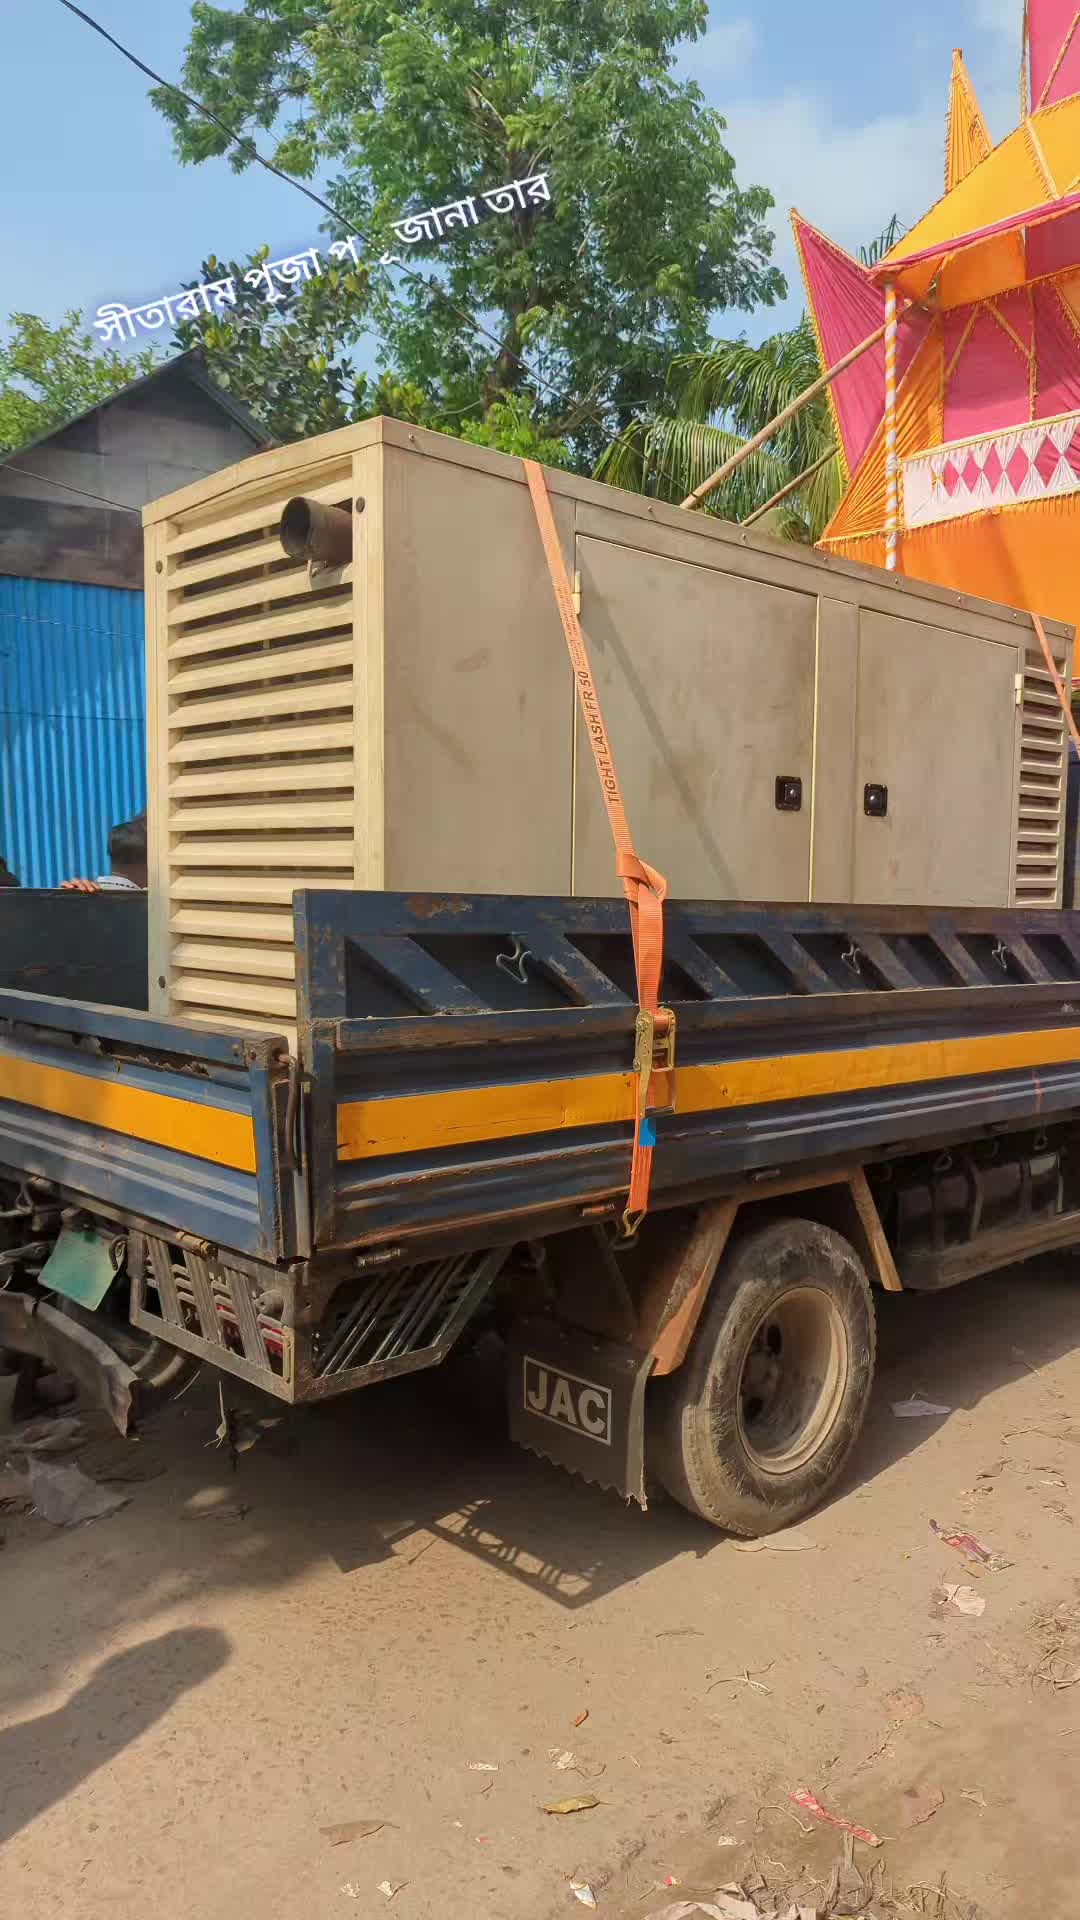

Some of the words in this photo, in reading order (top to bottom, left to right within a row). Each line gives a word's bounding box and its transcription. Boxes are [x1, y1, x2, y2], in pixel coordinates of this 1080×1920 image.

[577, 671, 591, 688] 50
[582, 691, 598, 710] FR
[588, 714, 609, 755] LASH
[598, 758, 620, 802] TIGHT
[527, 1369, 606, 1434] JAC
